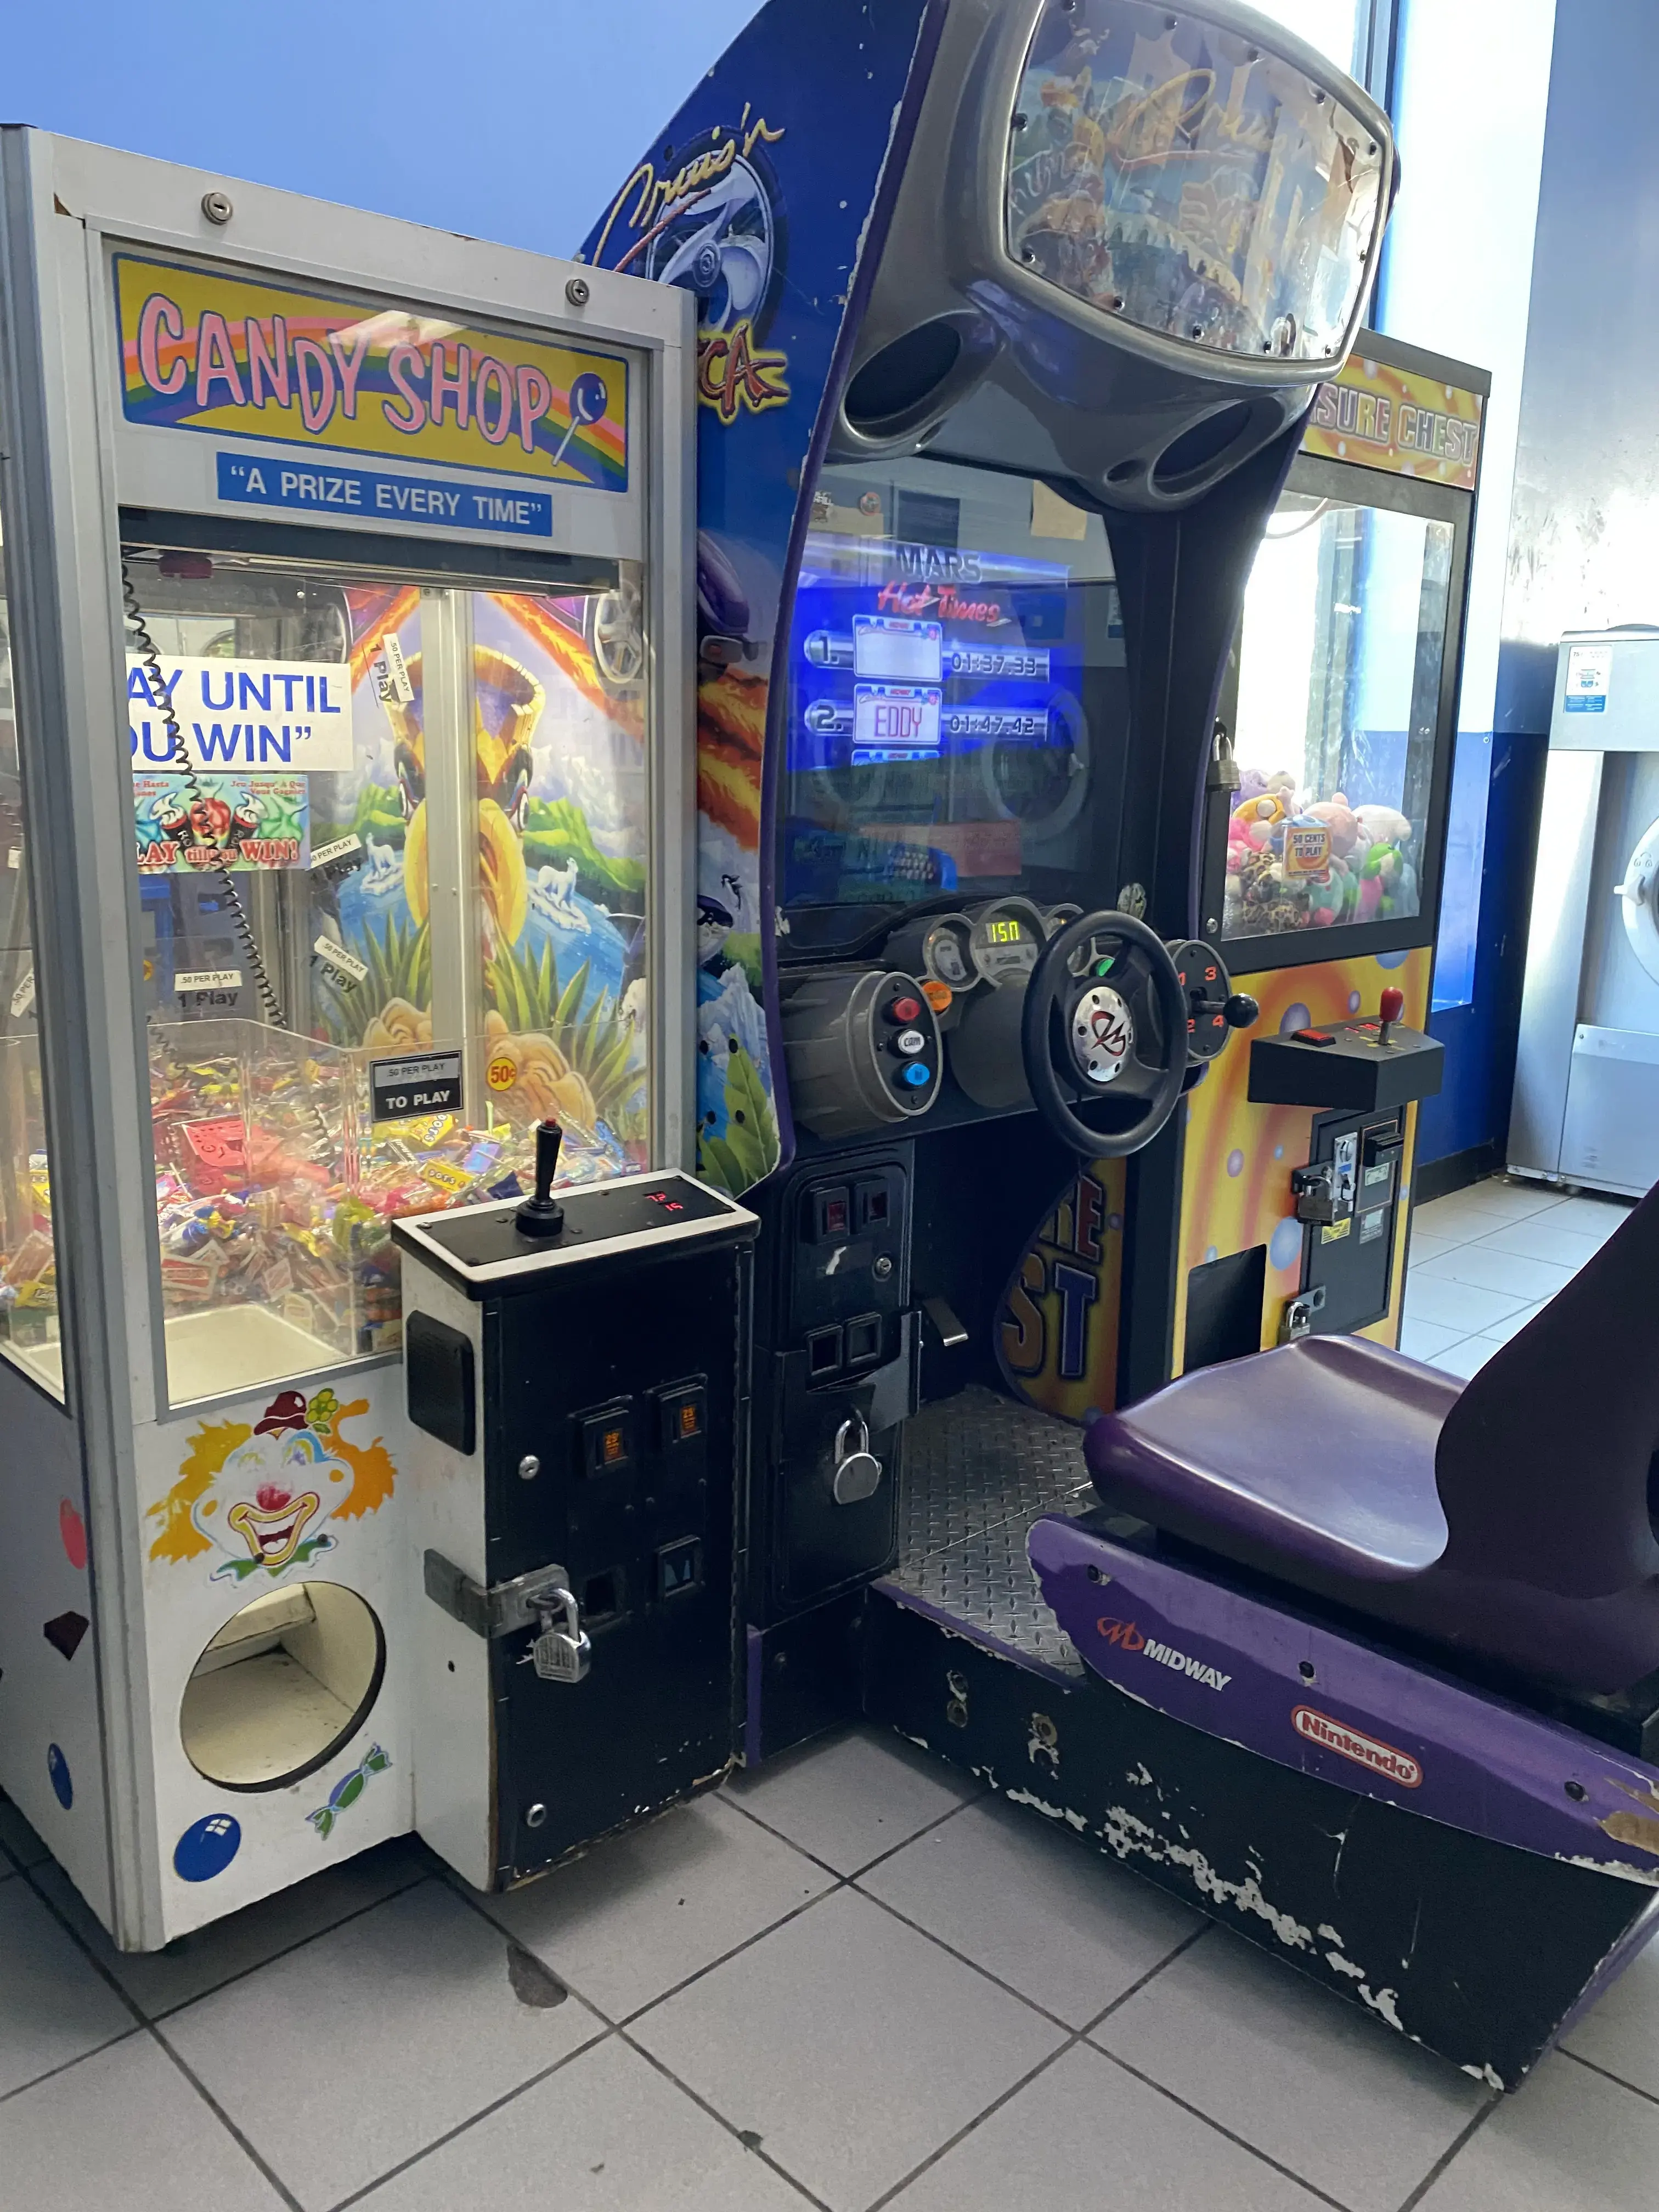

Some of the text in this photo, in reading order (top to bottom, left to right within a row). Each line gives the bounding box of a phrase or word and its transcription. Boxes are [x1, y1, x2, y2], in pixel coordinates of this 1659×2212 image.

[137, 292, 551, 454] CANDY SHOP
[1311, 382, 1479, 467] SURE CHEST
[281, 472, 362, 506] PRIZE
[376, 484, 461, 517] EVERY
[895, 545, 983, 585] MARS
[878, 579, 1002, 624] Hot Times
[373, 661, 392, 703] Play
[394, 654, 403, 670] PER
[399, 670, 410, 692] PLAY
[201, 670, 341, 714] UNTIL
[873, 704, 923, 739] EDDY
[239, 838, 300, 862] WIN!
[318, 848, 333, 860] PER
[333, 838, 352, 853] PLAY
[193, 974, 211, 983] PER
[212, 972, 234, 981] PLAY
[320, 961, 357, 993] Play
[1204, 966, 1217, 981] 3
[195, 990, 239, 1007] Play
[1212, 1014, 1224, 1028] 4
[401, 1065, 420, 1075] PER
[421, 1062, 446, 1072] PLAY
[385, 1090, 450, 1110] TO PLAY
[428, 1169, 456, 1185] DOTS
[1143, 1638, 1233, 1691] MIDWAY
[1301, 1711, 1414, 1780] Nintendo
